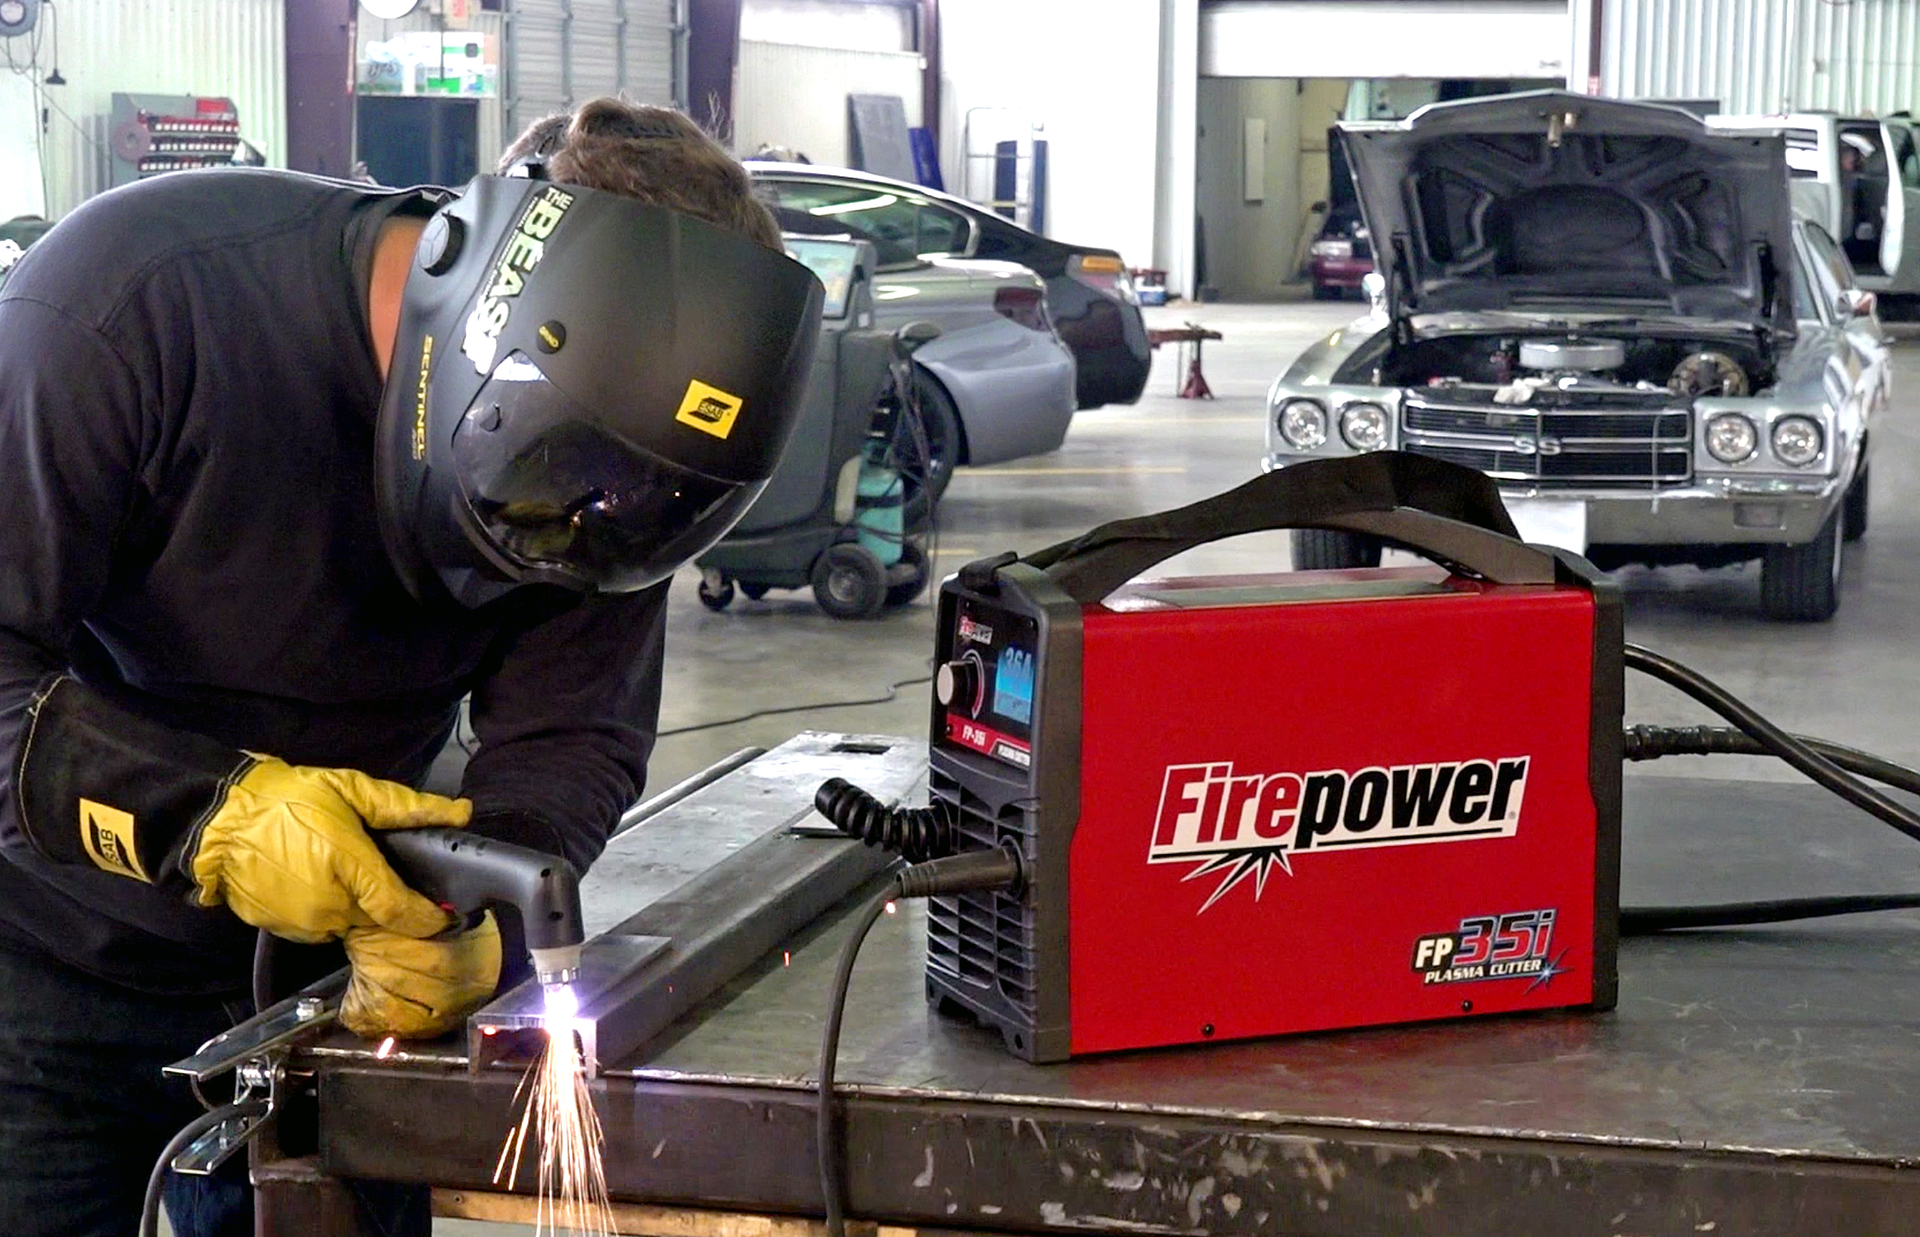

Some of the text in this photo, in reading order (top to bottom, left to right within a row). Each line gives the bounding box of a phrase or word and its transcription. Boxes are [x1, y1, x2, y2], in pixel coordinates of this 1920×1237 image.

[545, 187, 575, 211] THE
[416, 335, 434, 461] SENTINEL
[1153, 755, 1527, 850] Firepower
[1424, 958, 1542, 985] PLASMA CUTTER
